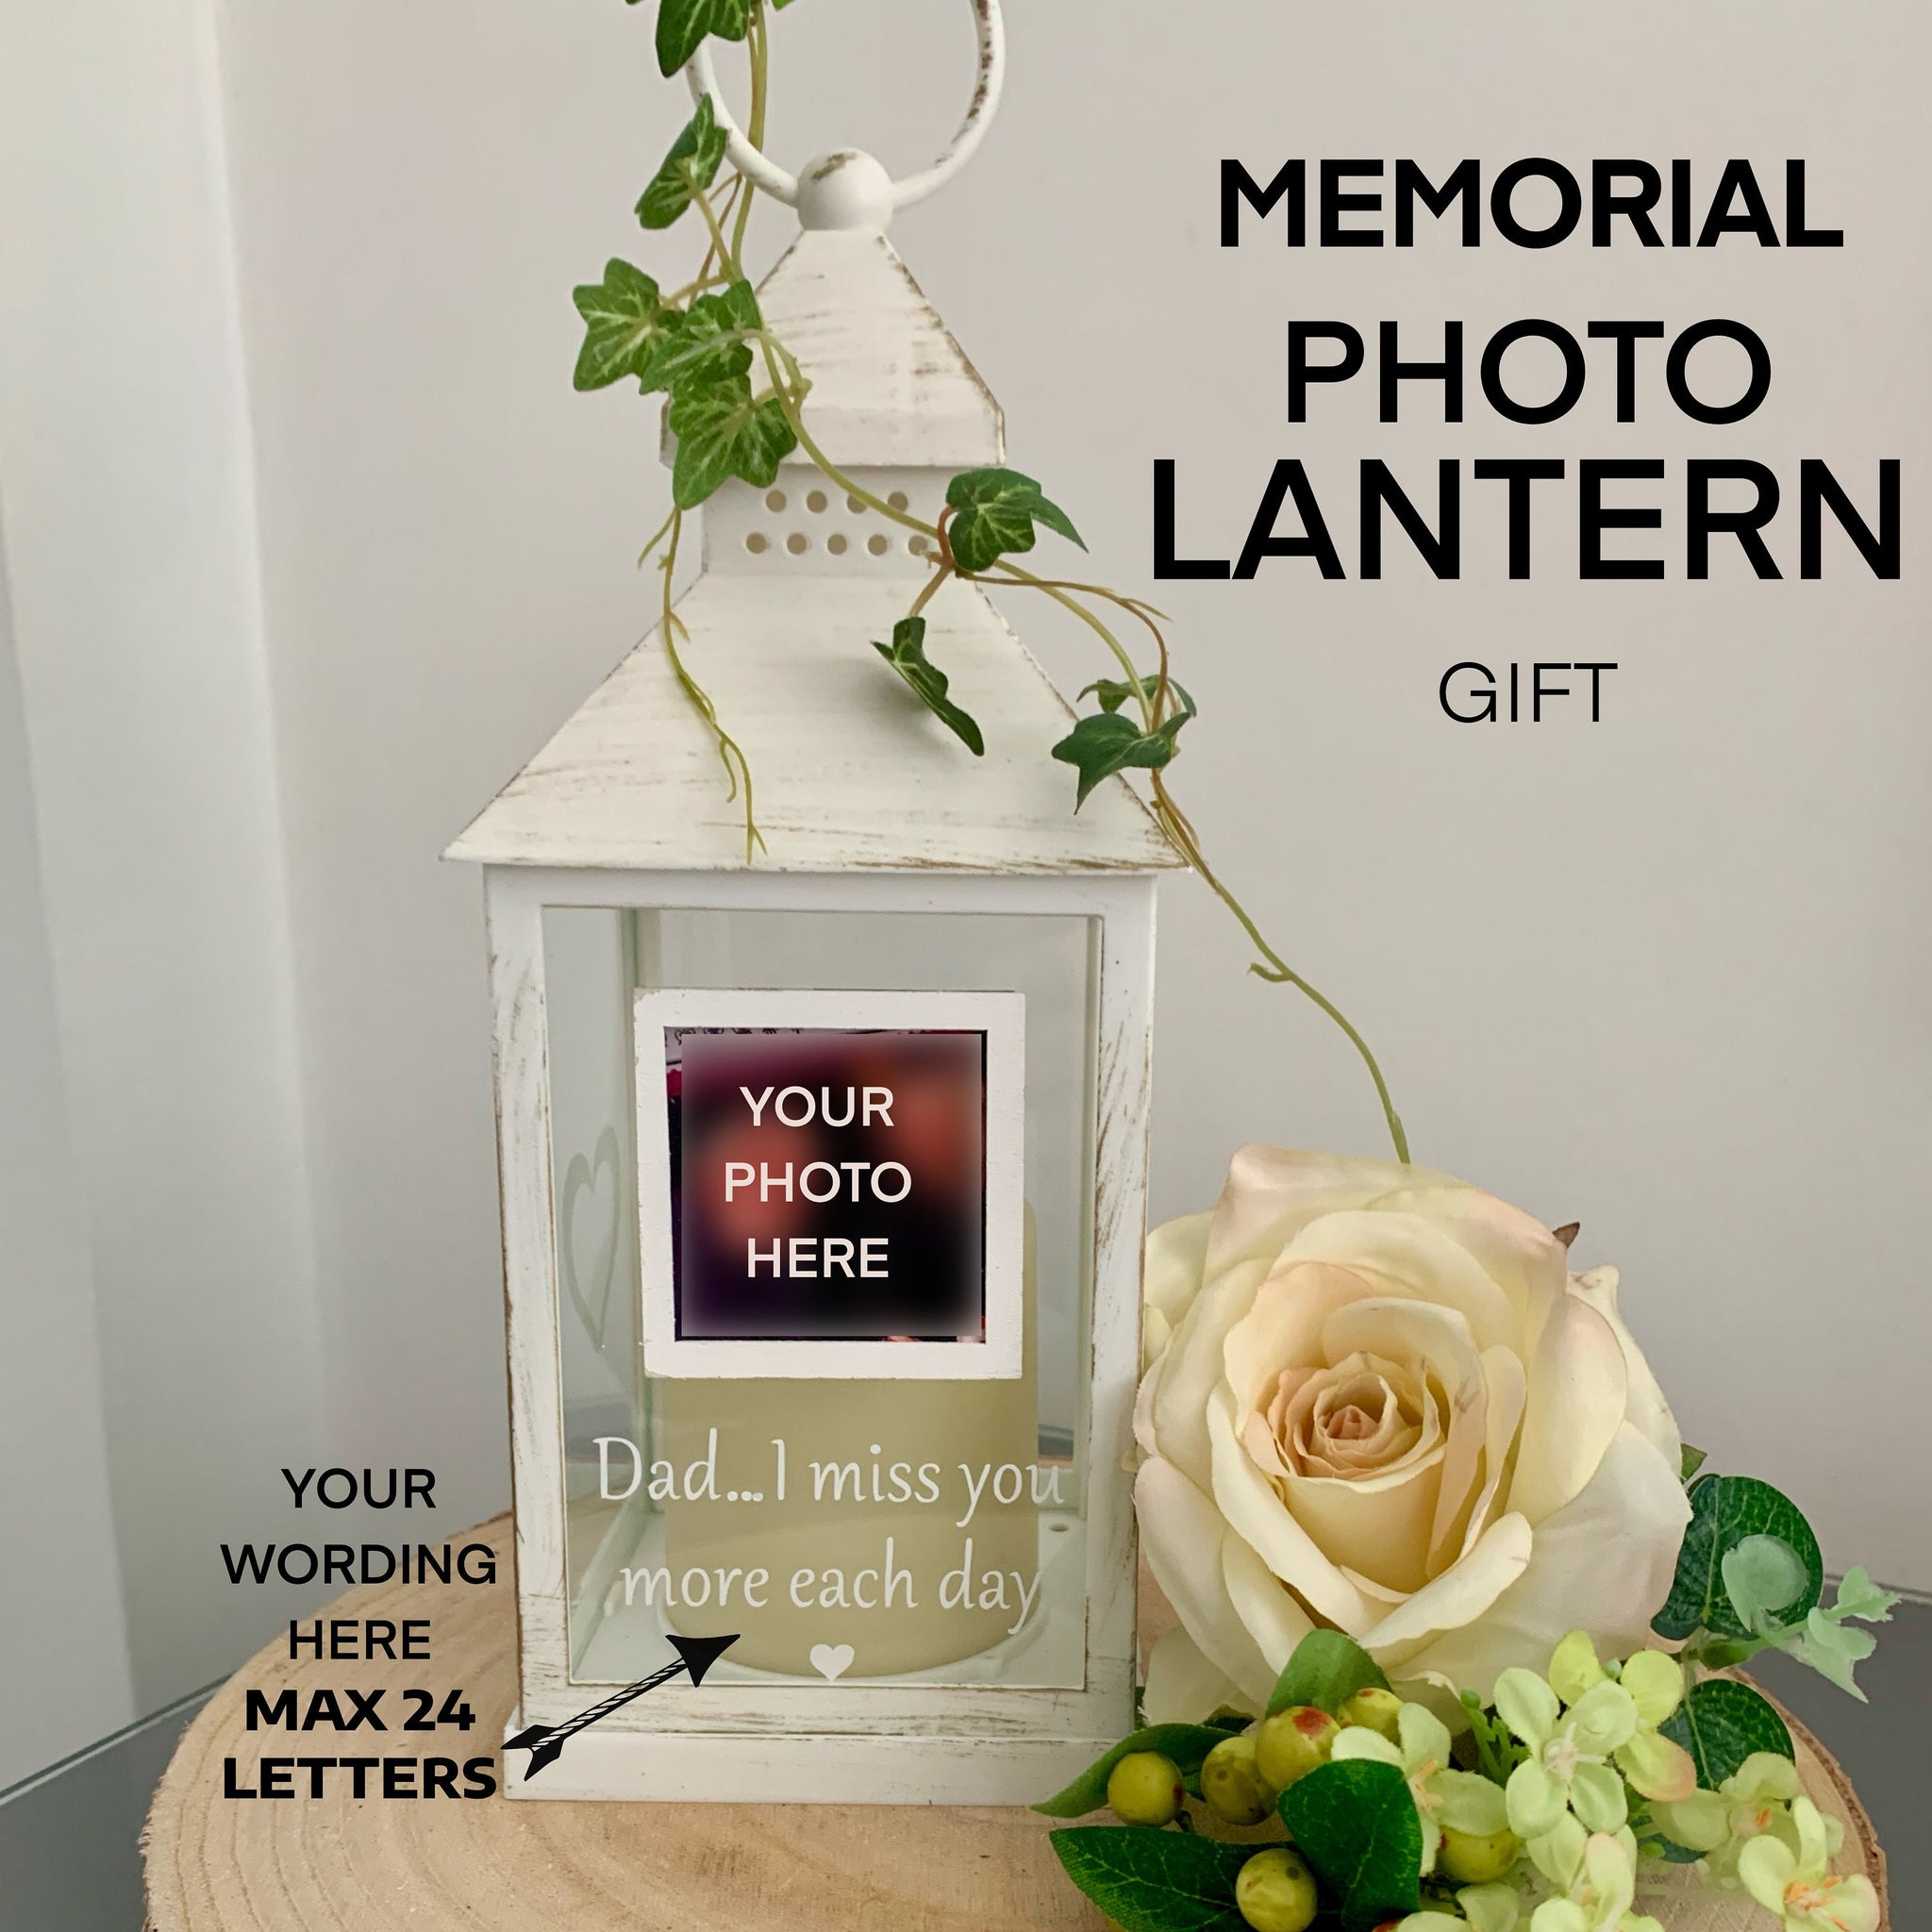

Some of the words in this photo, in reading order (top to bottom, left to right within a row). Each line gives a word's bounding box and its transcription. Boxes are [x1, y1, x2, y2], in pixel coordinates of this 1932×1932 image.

[808, 1444, 941, 1503] miss
[956, 1460, 1065, 1527] you
[620, 1565, 770, 1608] more
[790, 1537, 918, 1608] each
[939, 1538, 1041, 1635] day
